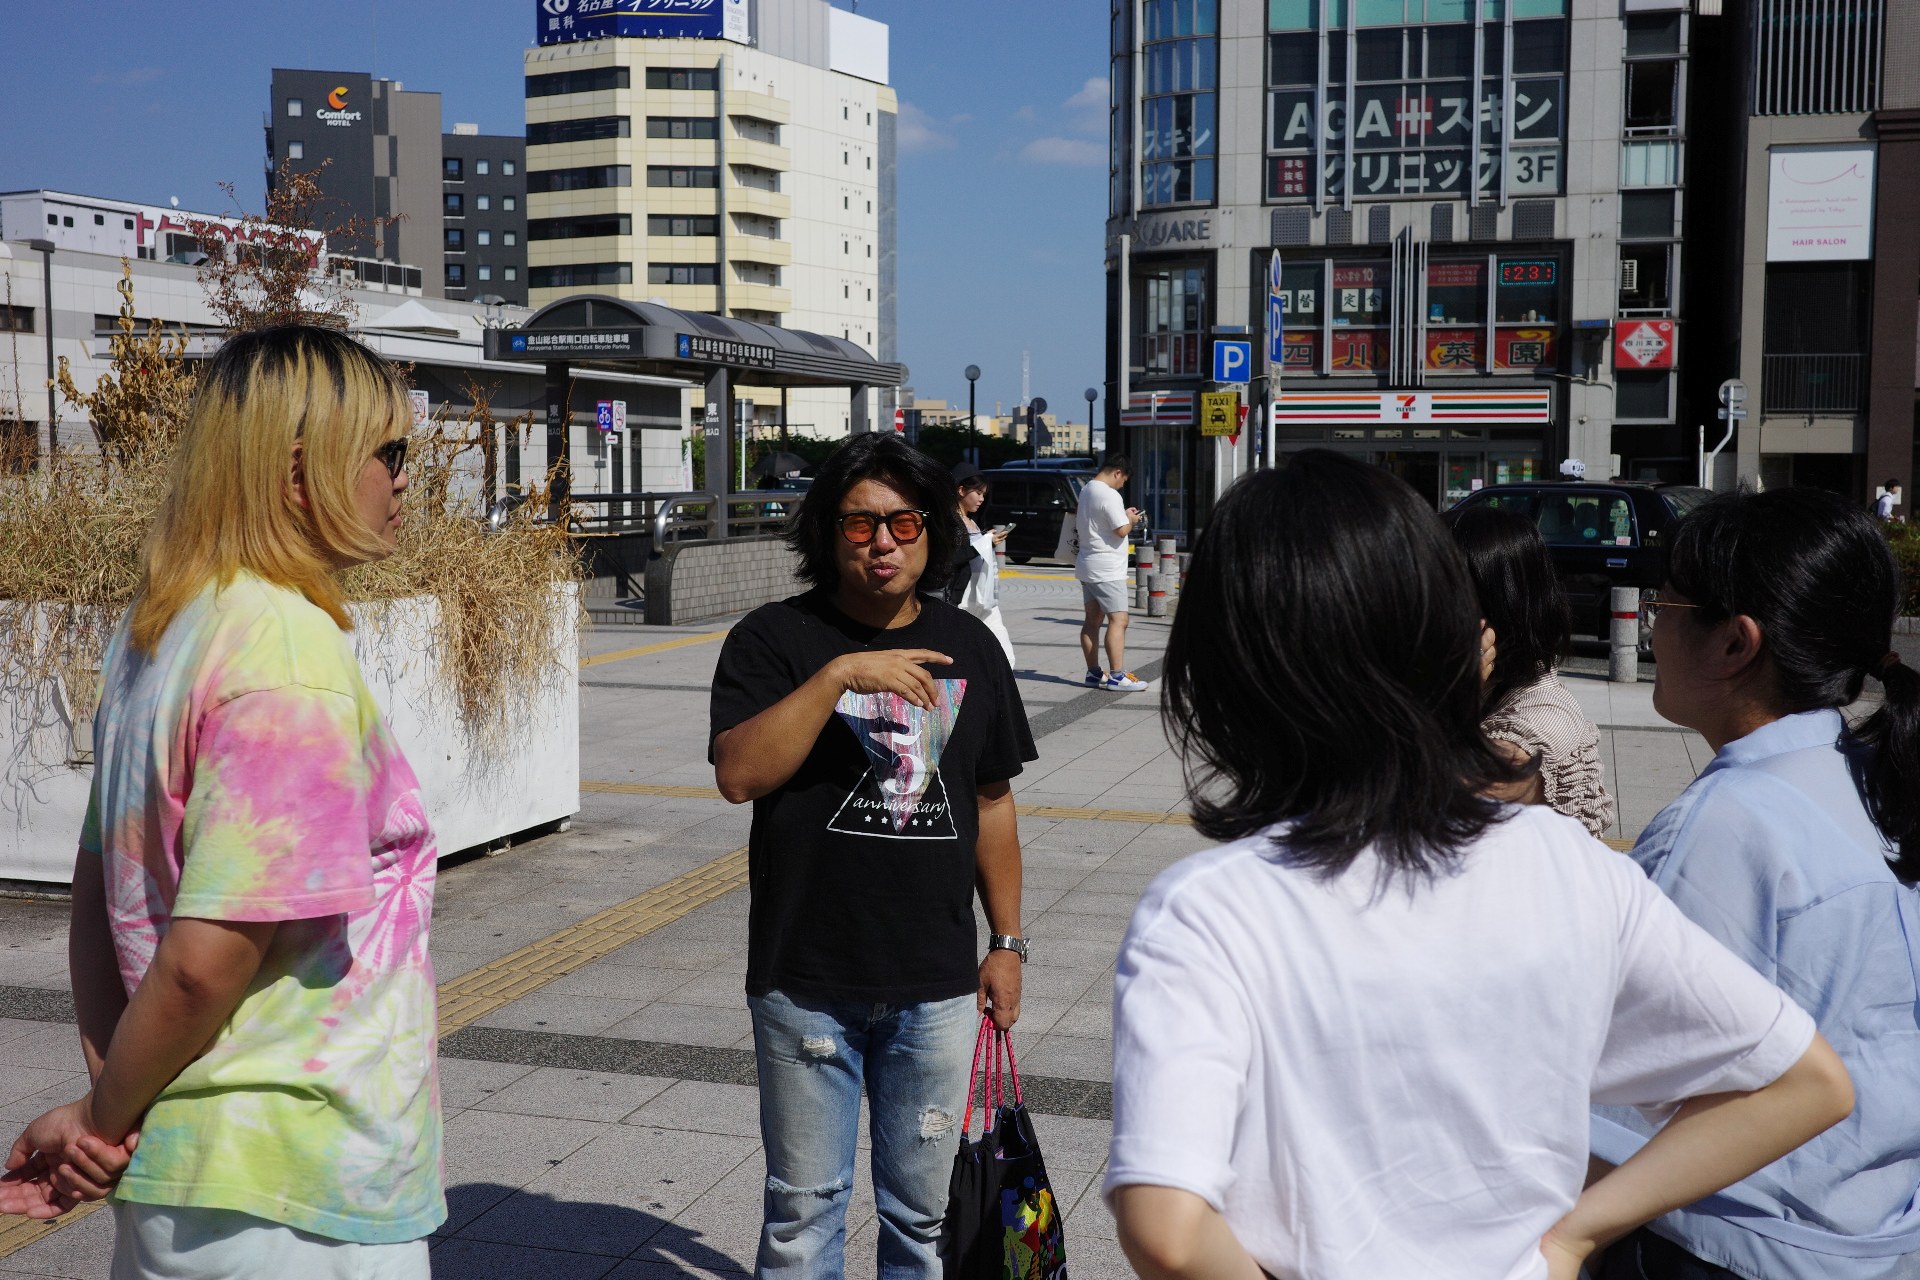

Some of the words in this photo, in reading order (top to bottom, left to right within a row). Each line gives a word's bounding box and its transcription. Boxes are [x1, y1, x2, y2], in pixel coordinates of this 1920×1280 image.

[548, 16, 575, 31] 眼科
[316, 108, 361, 120] Comfort
[1283, 98, 1392, 141] AGA
[1436, 92, 1553, 134] スキン
[1324, 151, 1500, 194] クリニック
[1516, 155, 1557, 184] 3F
[1816, 238, 1847, 246] SALON
[1272, 302, 1281, 356] P
[1223, 345, 1245, 378] P
[707, 402, 718, 416] 東
[1207, 398, 1229, 406] TAXI
[1396, 394, 1416, 419] 7
[705, 428, 720, 436] 出入口
[884, 730, 927, 795] 5
[852, 796, 946, 820] anniversary
